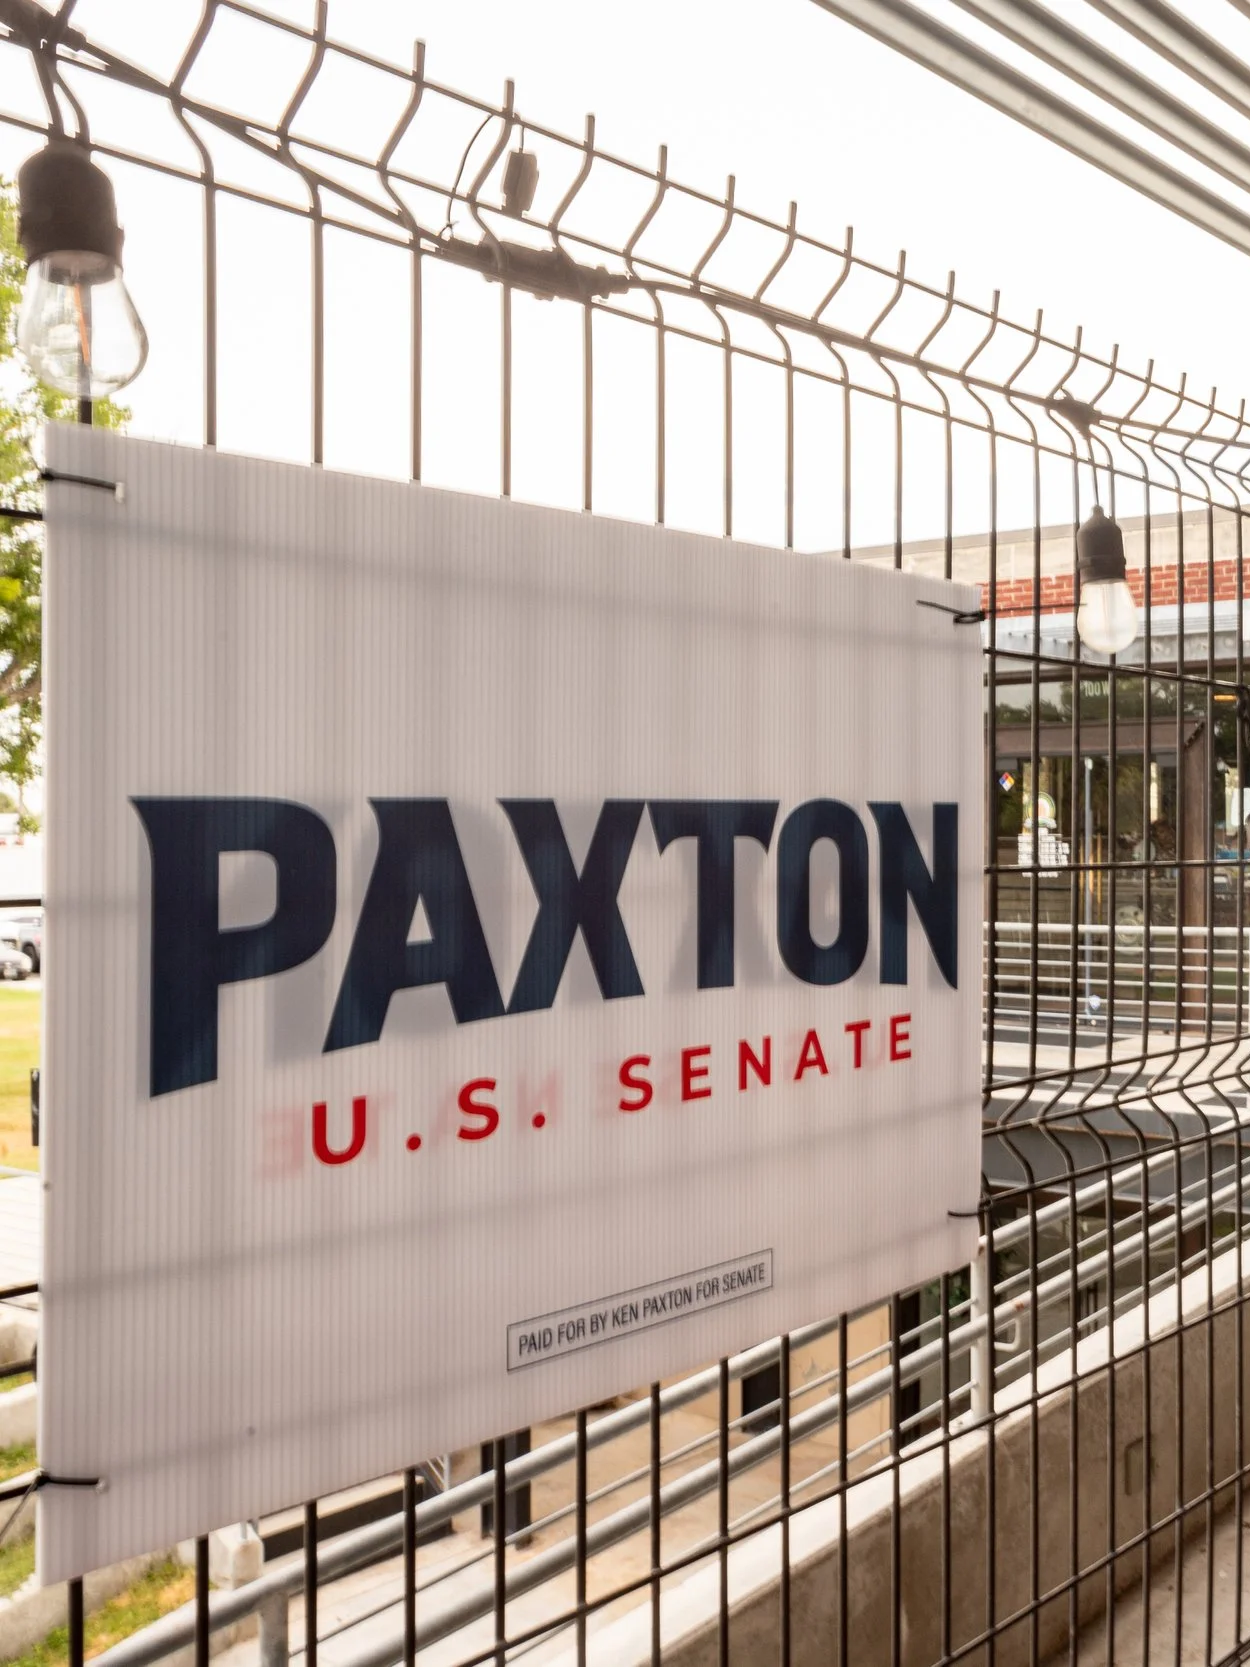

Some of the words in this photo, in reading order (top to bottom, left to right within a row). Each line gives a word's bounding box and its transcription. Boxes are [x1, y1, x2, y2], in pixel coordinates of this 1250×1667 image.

[128, 795, 959, 1099] PAXTON
[311, 1078, 547, 1165] U.S.
[618, 1014, 913, 1111] SENATE
[518, 1327, 553, 1356] PAID
[557, 1317, 586, 1344] FOR
[590, 1312, 609, 1335] BY
[611, 1301, 640, 1329] KEN
[642, 1286, 693, 1318] PAXTON
[696, 1277, 721, 1301] FOR
[722, 1263, 765, 1293] SENATE
